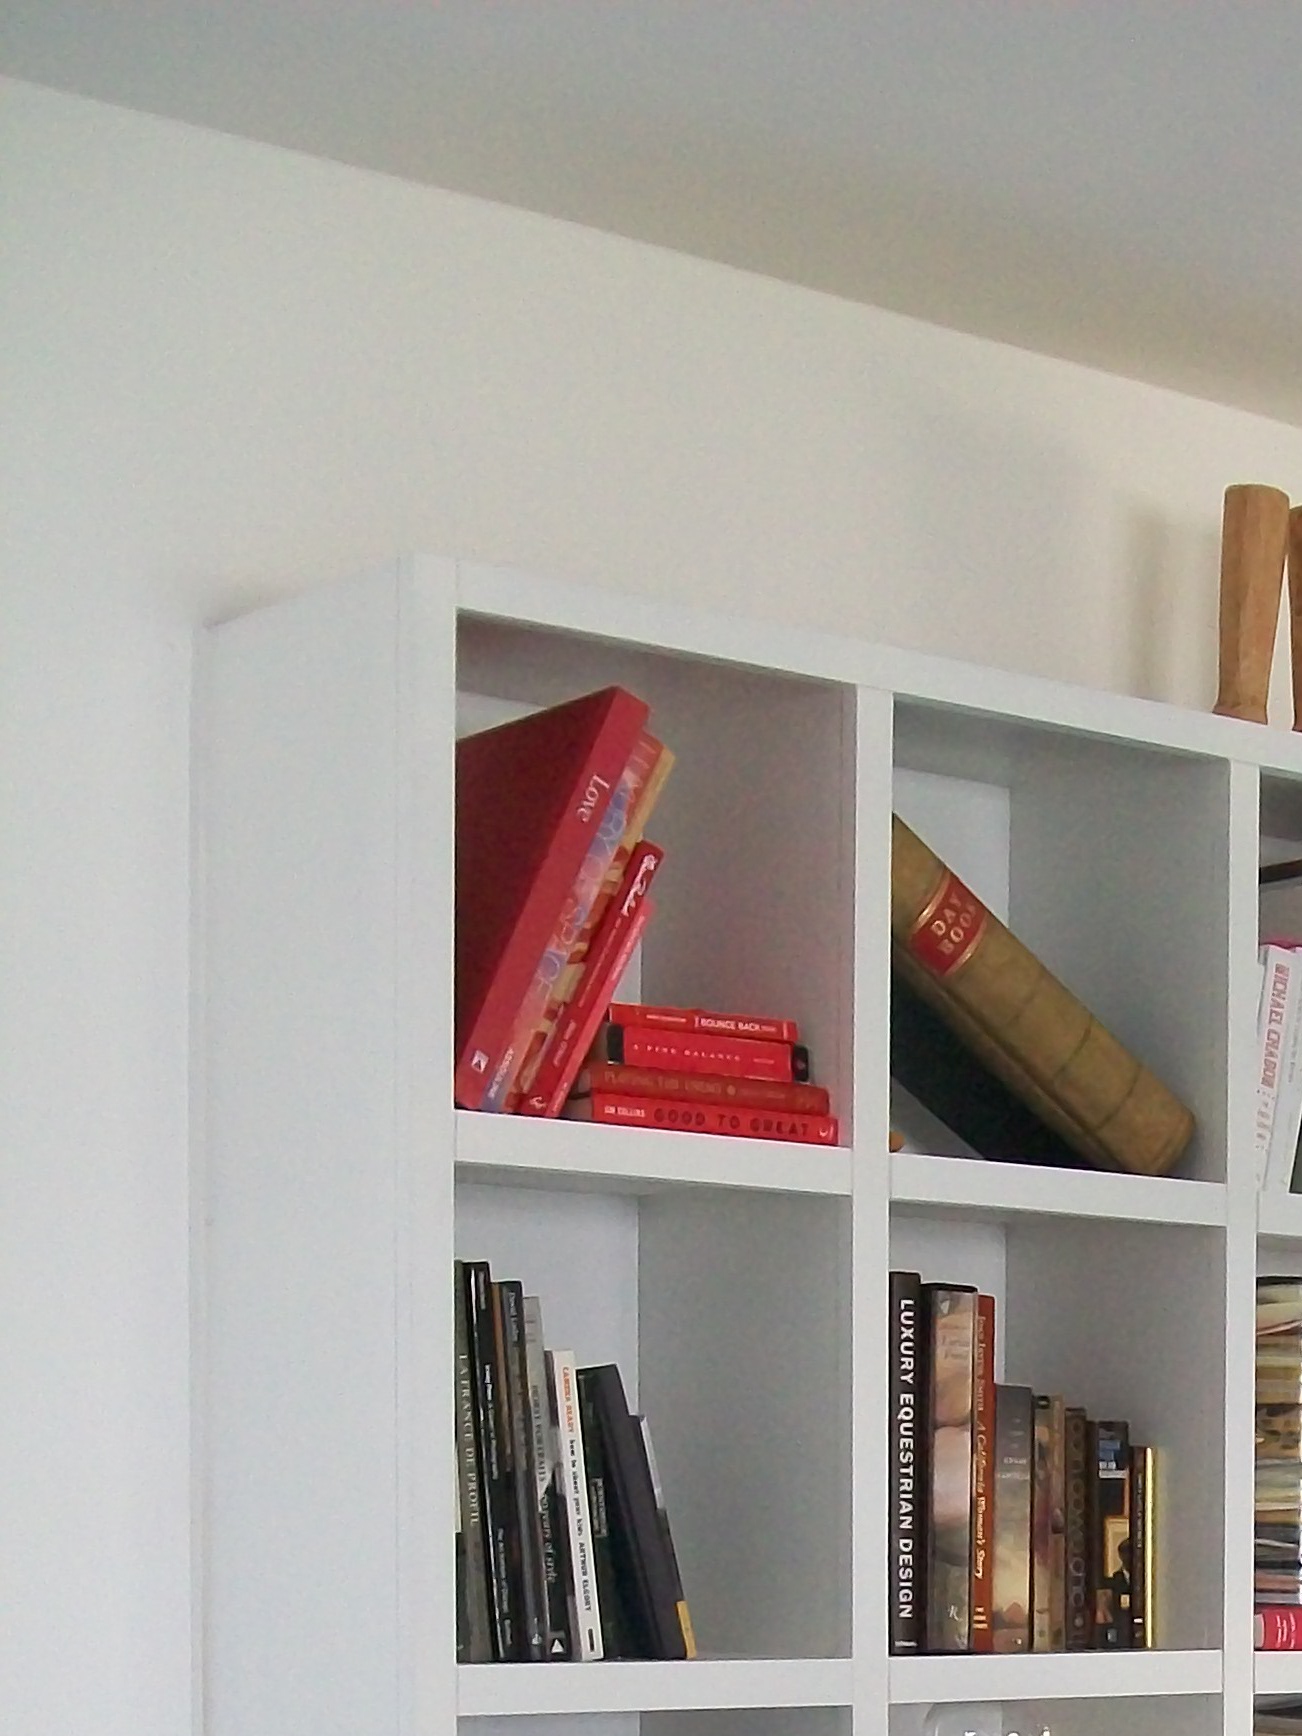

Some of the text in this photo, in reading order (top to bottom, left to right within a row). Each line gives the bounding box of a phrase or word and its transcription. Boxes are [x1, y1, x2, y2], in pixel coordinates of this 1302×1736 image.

[576, 774, 610, 823] Love
[931, 891, 962, 937] DAY
[937, 903, 977, 955] BOOK
[700, 1018, 737, 1031] BOUNCE
[1260, 962, 1290, 1089] MICHAEL CHABON
[653, 1107, 809, 1138] GOOD TO GREAT
[459, 1378, 476, 1442] FRANCE
[464, 1447, 476, 1468] DE
[895, 1298, 916, 1620] LUXURY EQUESTRIAN DESIGN
[466, 1471, 481, 1528] PROFIL
[974, 1548, 987, 1580] Story
